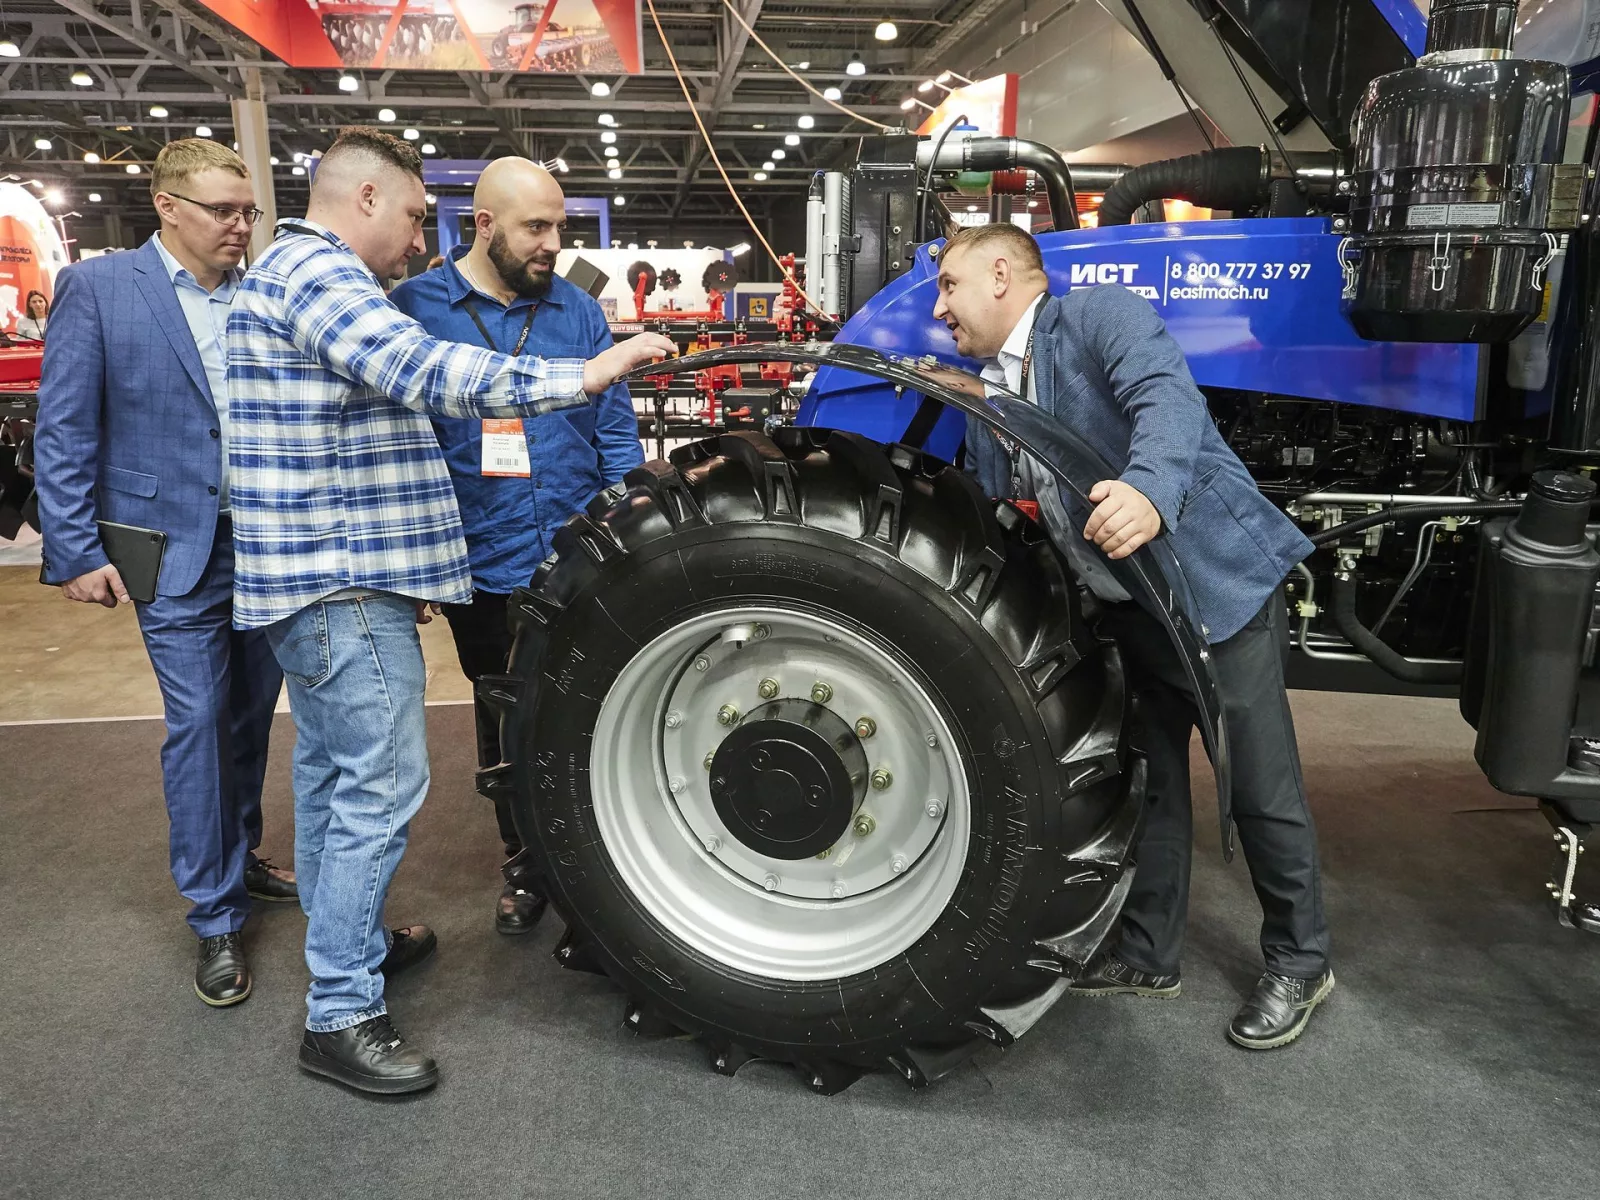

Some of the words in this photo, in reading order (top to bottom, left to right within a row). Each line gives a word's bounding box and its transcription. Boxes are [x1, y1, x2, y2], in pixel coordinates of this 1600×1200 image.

[1070, 263, 1139, 284] ИСТ
[1171, 263, 1182, 279] 8
[1189, 263, 1220, 279] 800
[1226, 263, 1257, 279] 777
[1262, 263, 1285, 279] 37
[1289, 263, 1312, 279] 97
[1170, 285, 1269, 300] eastmach.ru
